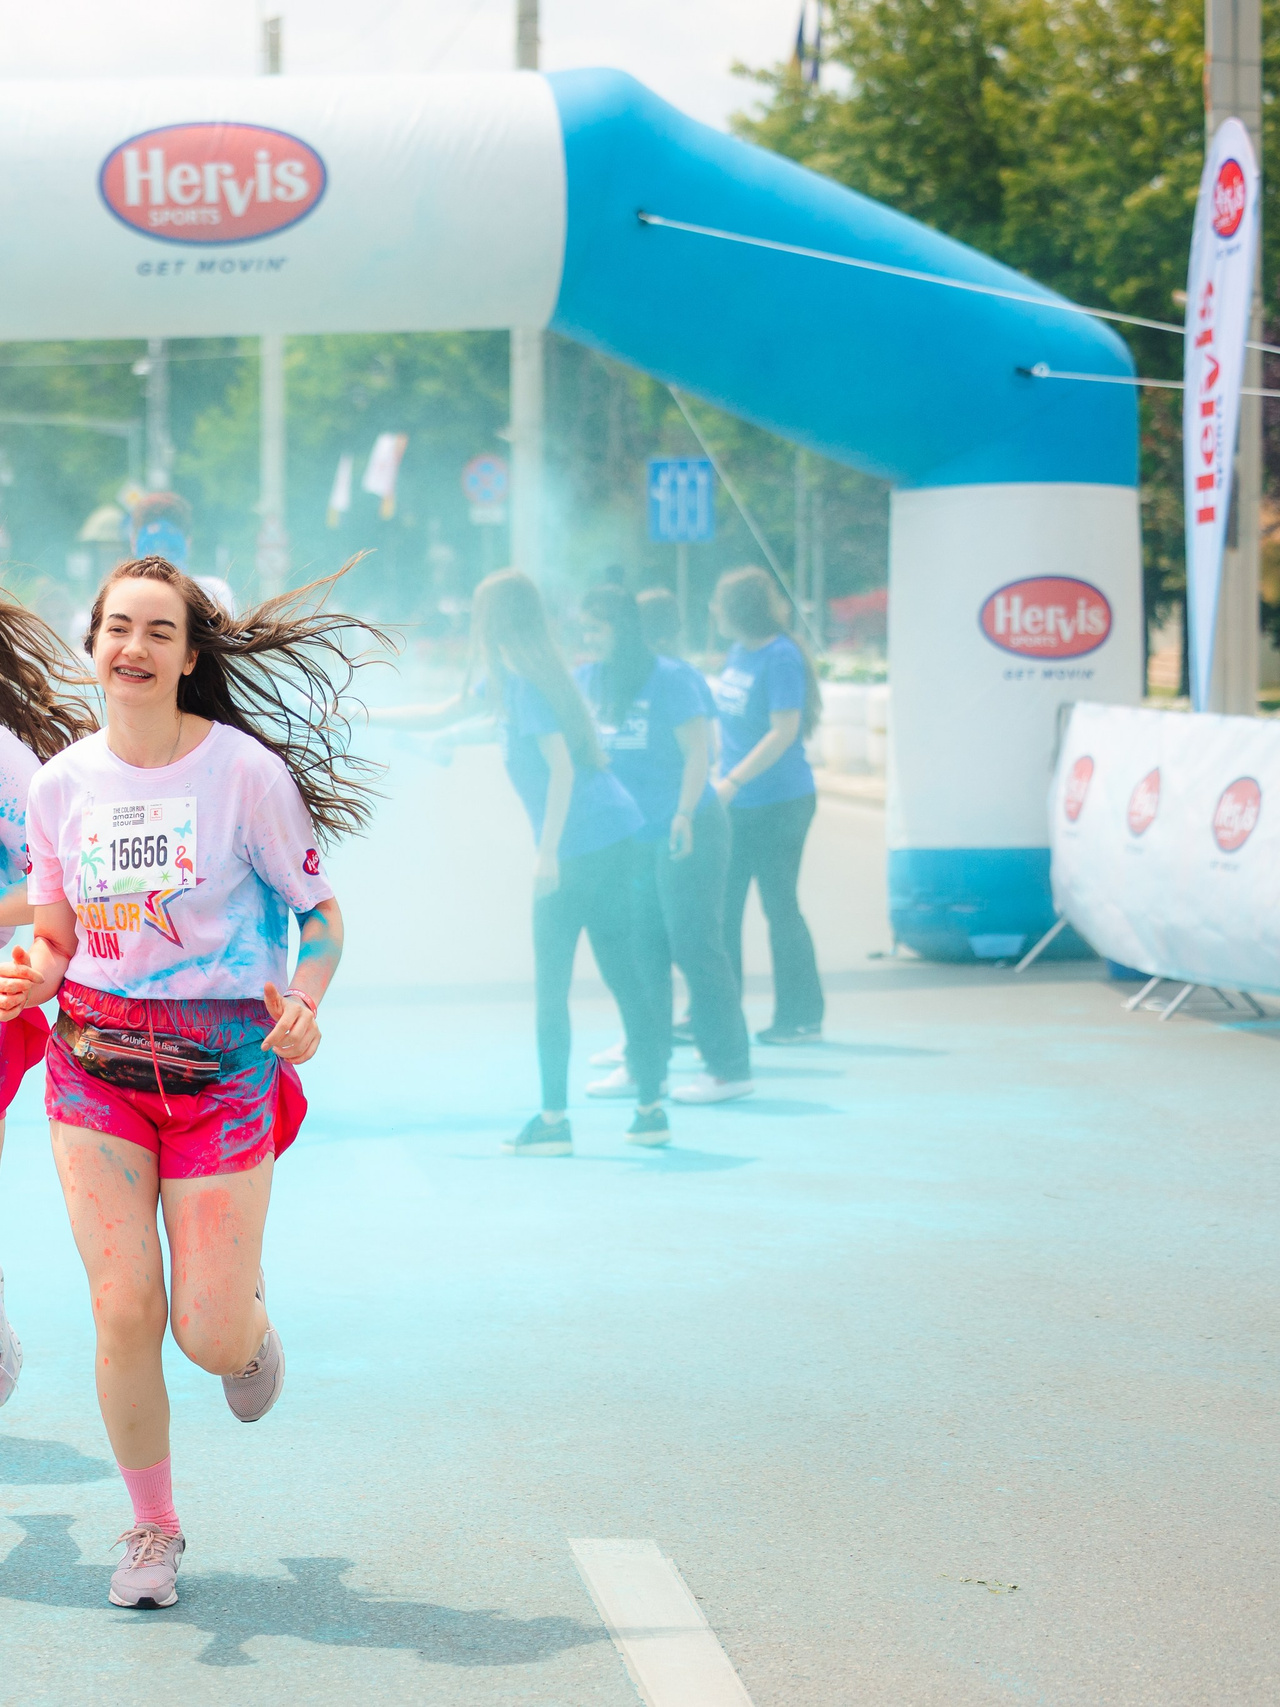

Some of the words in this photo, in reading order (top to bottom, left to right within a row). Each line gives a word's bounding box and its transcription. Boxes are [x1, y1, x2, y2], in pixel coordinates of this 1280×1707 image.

[123, 147, 310, 218] Hervis
[148, 207, 222, 227] SPORTS
[135, 258, 186, 277] GET
[994, 595, 1107, 643] Hervis
[1009, 634, 1059, 648] SPORTS
[112, 812, 145, 820] amazing
[109, 834, 168, 872] 15656
[76, 903, 141, 932] COLOR
[86, 929, 121, 961] RUN
[161, 1042, 180, 1053] Bank
